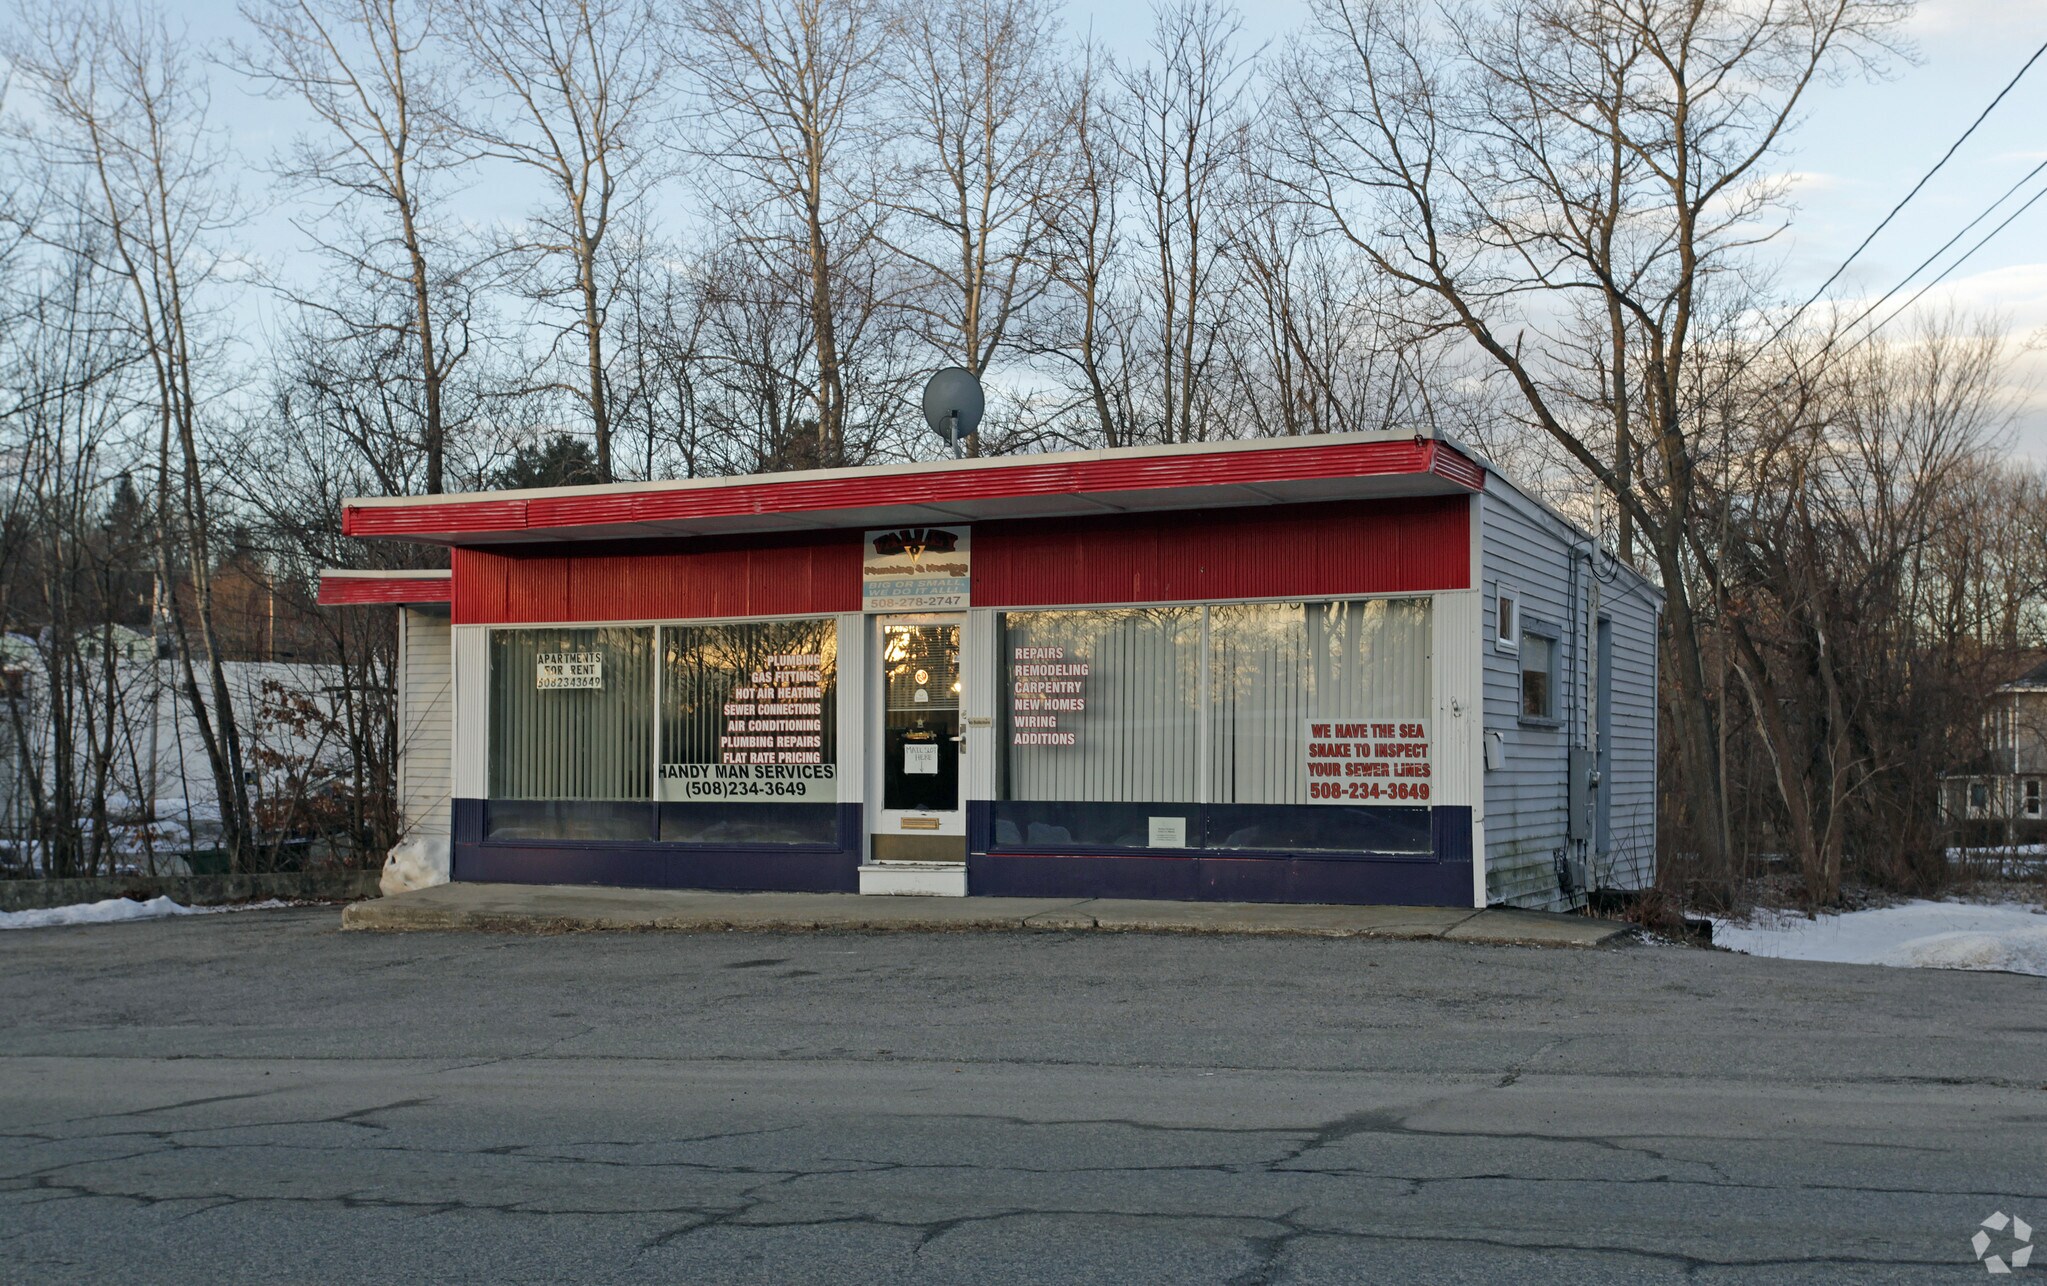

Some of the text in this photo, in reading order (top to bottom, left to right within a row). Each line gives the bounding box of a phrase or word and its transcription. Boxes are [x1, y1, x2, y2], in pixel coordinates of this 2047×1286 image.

[895, 580, 914, 588] OR
[871, 596, 961, 608] 508-278-2747
[537, 652, 601, 664] APARTMENTS
[1014, 647, 1064, 660] REPAIRS
[767, 654, 821, 667] PLUMBING
[544, 664, 595, 675] FOR RENT
[1014, 664, 1089, 677] REMODELING
[537, 676, 601, 688] 5082343649
[751, 670, 821, 683] GAS FITTINGS
[735, 686, 821, 700] HOT AIR HEATING
[1014, 681, 1082, 693] CARPENTRY
[723, 702, 821, 716] SEWER CONNECTIONS
[1014, 698, 1085, 711] NEW HOMES
[727, 719, 821, 732] AIR CONDITIONING
[1013, 715, 1057, 728] WIRING
[1311, 723, 1425, 738] WE HAVE THE SEA
[720, 735, 821, 748] PLUMBING REPAIRS
[1013, 732, 1076, 745] ADDITIONS
[1309, 743, 1429, 758] SNAKE TO INSPECT
[723, 751, 821, 764] FLAT RATE PRICING
[659, 764, 834, 779] HANDY MAN SERVICES
[1307, 762, 1431, 778] YOUR SEWER LINES
[685, 781, 807, 798] (508)234-3649
[1310, 782, 1430, 800] 508-234-3649
